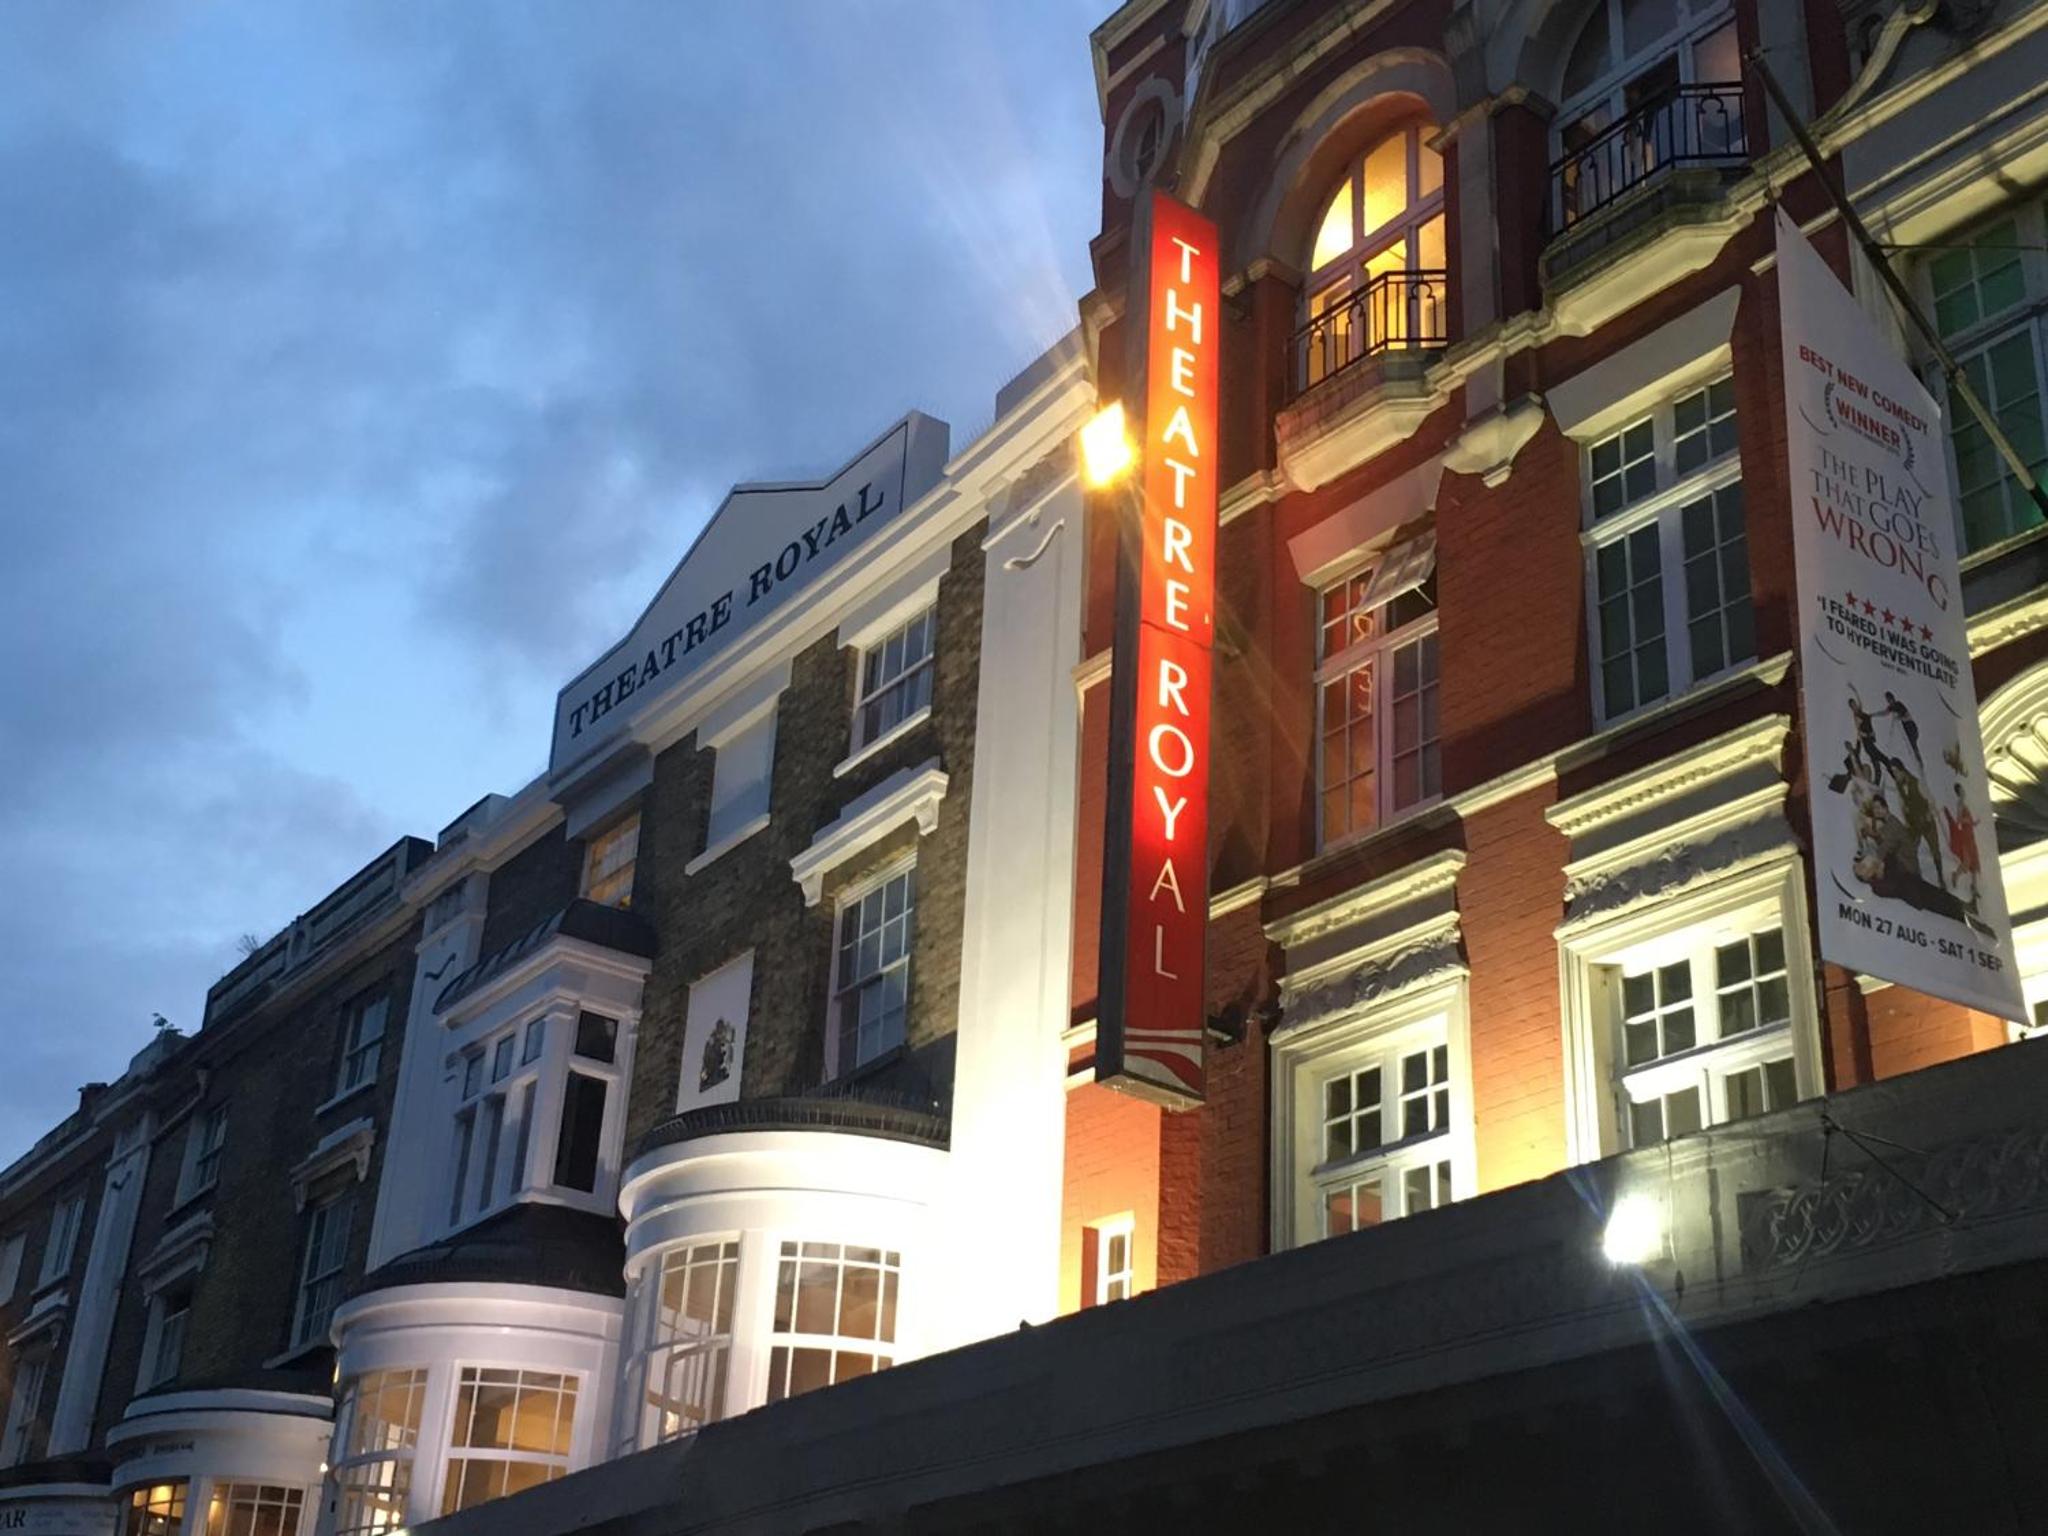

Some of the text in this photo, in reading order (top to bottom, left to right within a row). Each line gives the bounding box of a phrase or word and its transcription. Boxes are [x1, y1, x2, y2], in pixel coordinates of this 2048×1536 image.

[1799, 344, 1928, 435] BEST NEW COMEDY
[1836, 397, 1901, 448] WINNER
[1810, 467, 1941, 561] THAT GOES
[1817, 445, 1922, 519] THE PLAY
[1810, 496, 1949, 613] WRONG
[568, 482, 885, 740] THEATRE ROYAL
[1148, 237, 1202, 981] THEATRE ROYAL
[1826, 615, 1845, 635] TO
[1829, 599, 1877, 637] FEARED
[1887, 630, 1918, 655] WAS
[1920, 645, 1960, 676] GOING
[1838, 903, 1872, 930] MON
[1875, 917, 1893, 936] 27
[1896, 924, 1928, 948] AUG
[1938, 938, 1964, 961] SAT
[1967, 948, 1975, 964] 1
[1978, 953, 2004, 973] SEP
